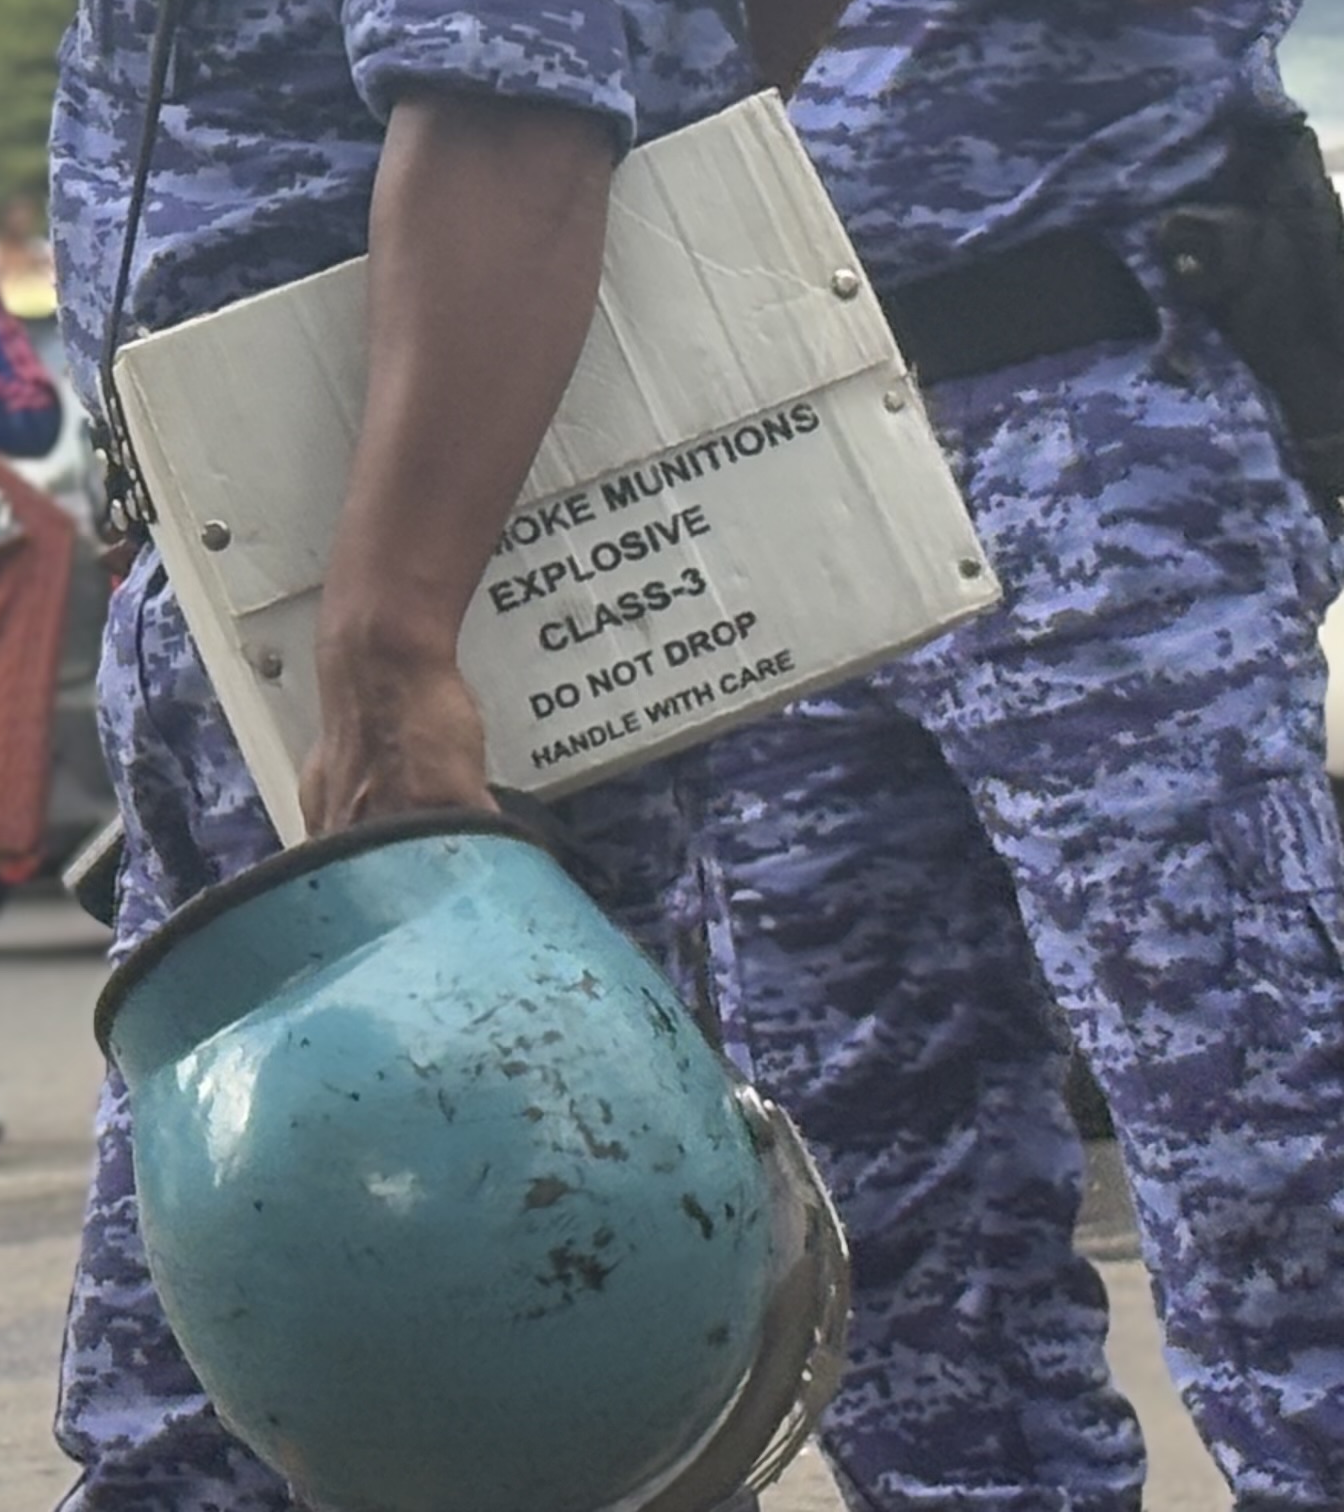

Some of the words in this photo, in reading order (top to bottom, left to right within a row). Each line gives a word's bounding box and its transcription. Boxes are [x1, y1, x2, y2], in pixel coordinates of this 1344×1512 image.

[602, 403, 821, 513] MUNITIONS
[487, 505, 711, 615] EXPLOSIVE
[538, 566, 708, 653] CLASS-3
[528, 682, 580, 720] DO
[588, 650, 654, 700] NOT
[665, 610, 758, 668] DROP
[530, 713, 642, 770] HANDLE
[643, 676, 715, 725] WITH
[718, 649, 796, 699] CARE
